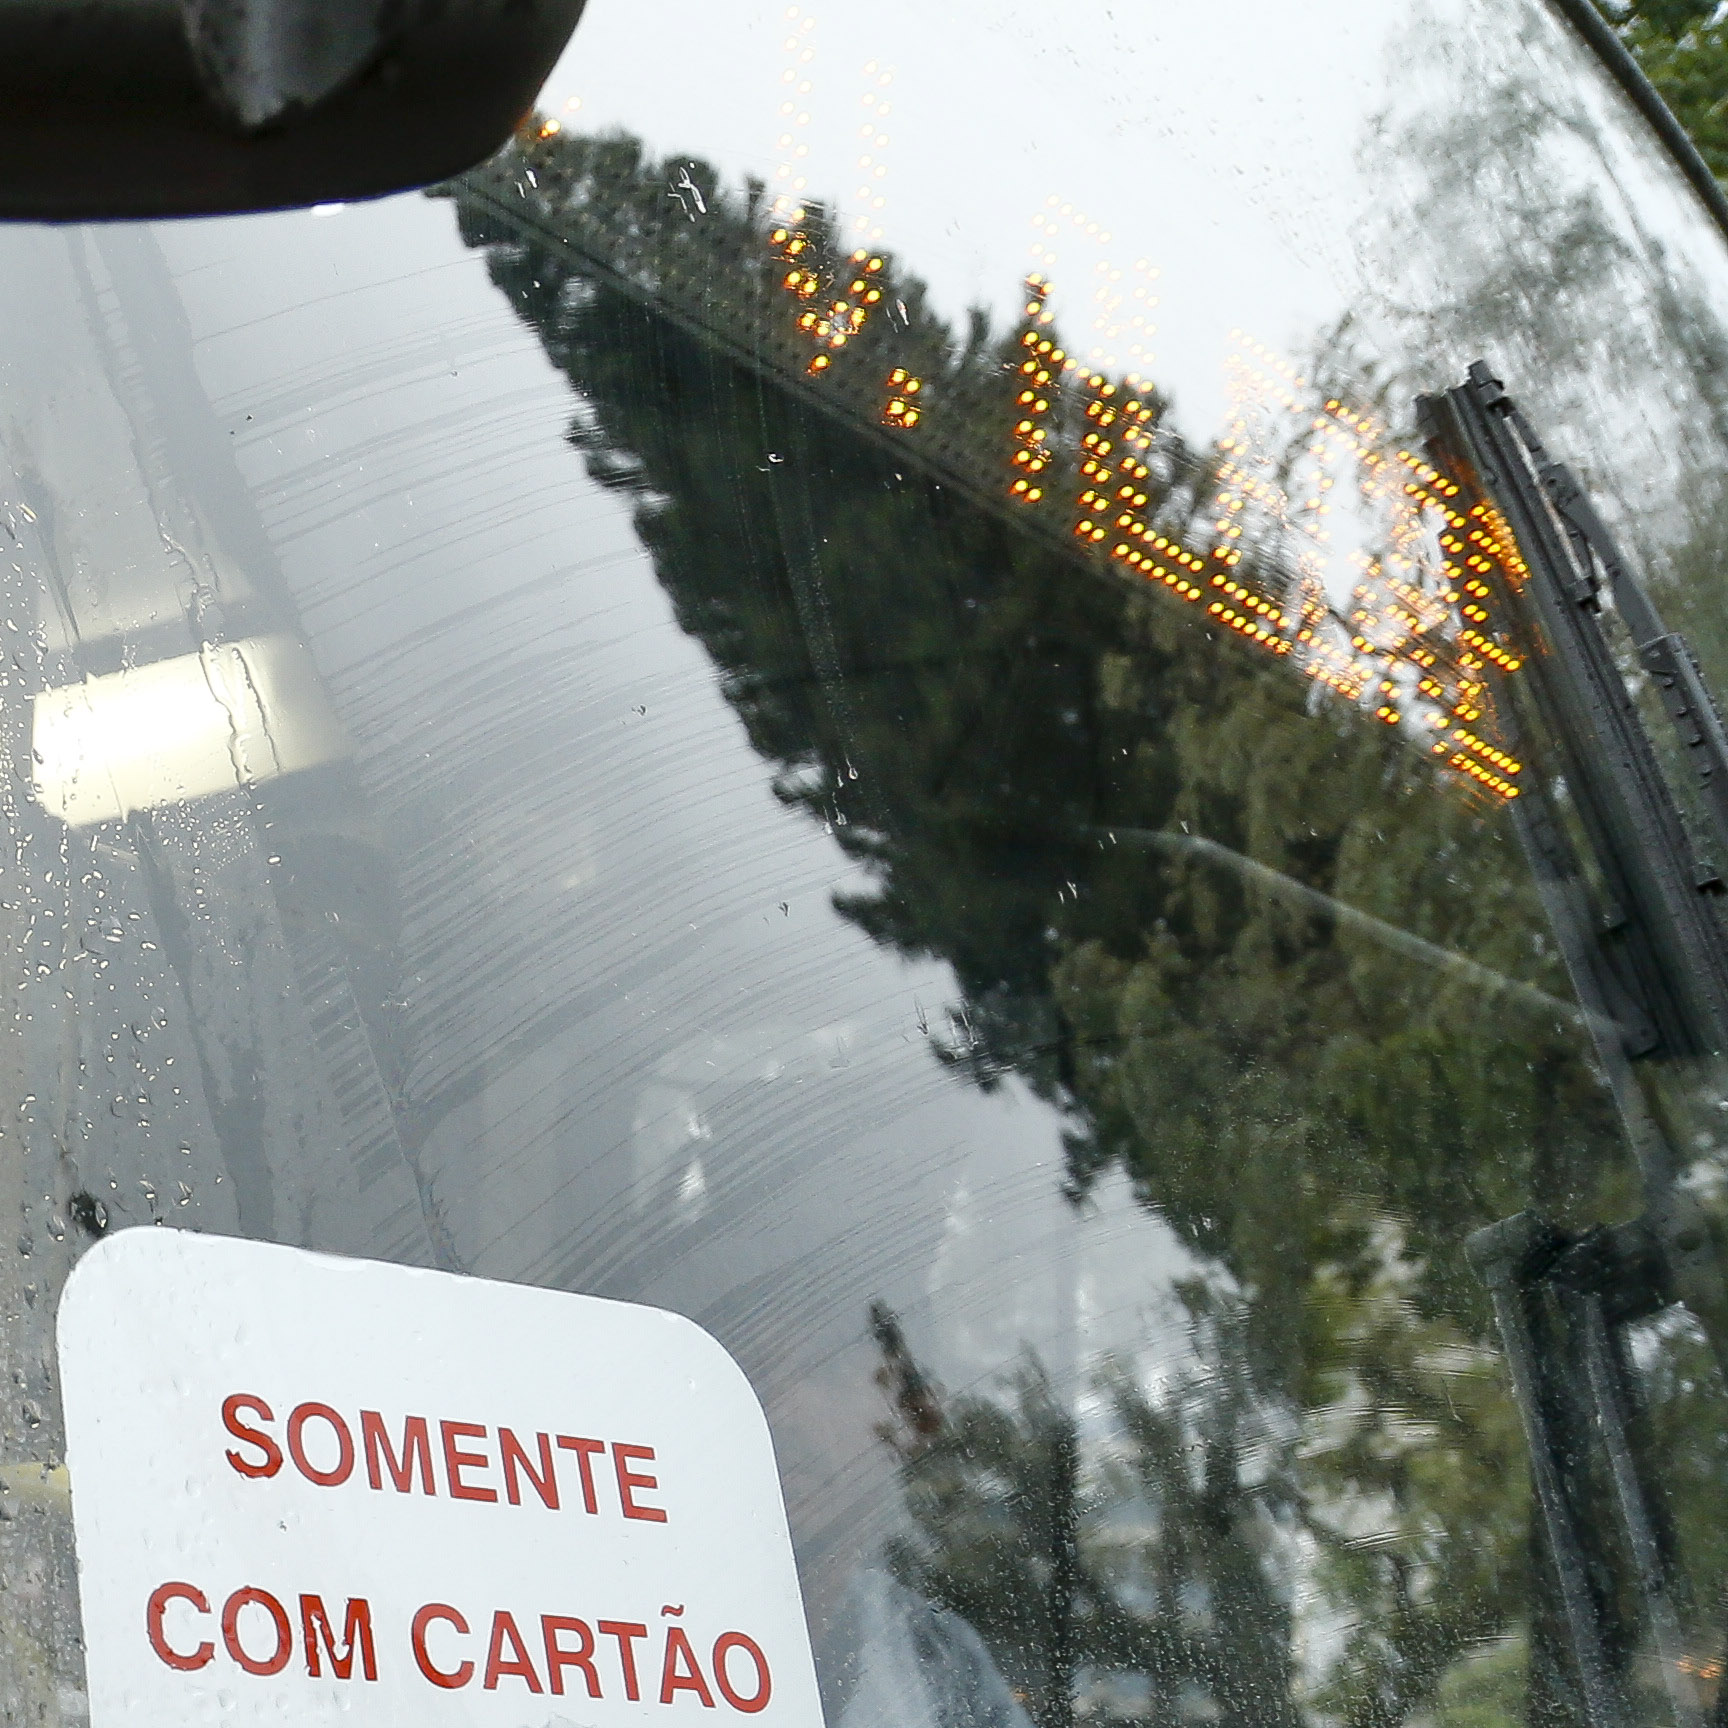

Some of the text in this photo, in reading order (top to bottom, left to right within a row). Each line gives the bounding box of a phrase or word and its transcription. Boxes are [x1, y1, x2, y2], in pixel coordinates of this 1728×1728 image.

[222, 1393, 668, 1523] SOMENTE
[146, 1581, 773, 1714] COM CARTÃO
